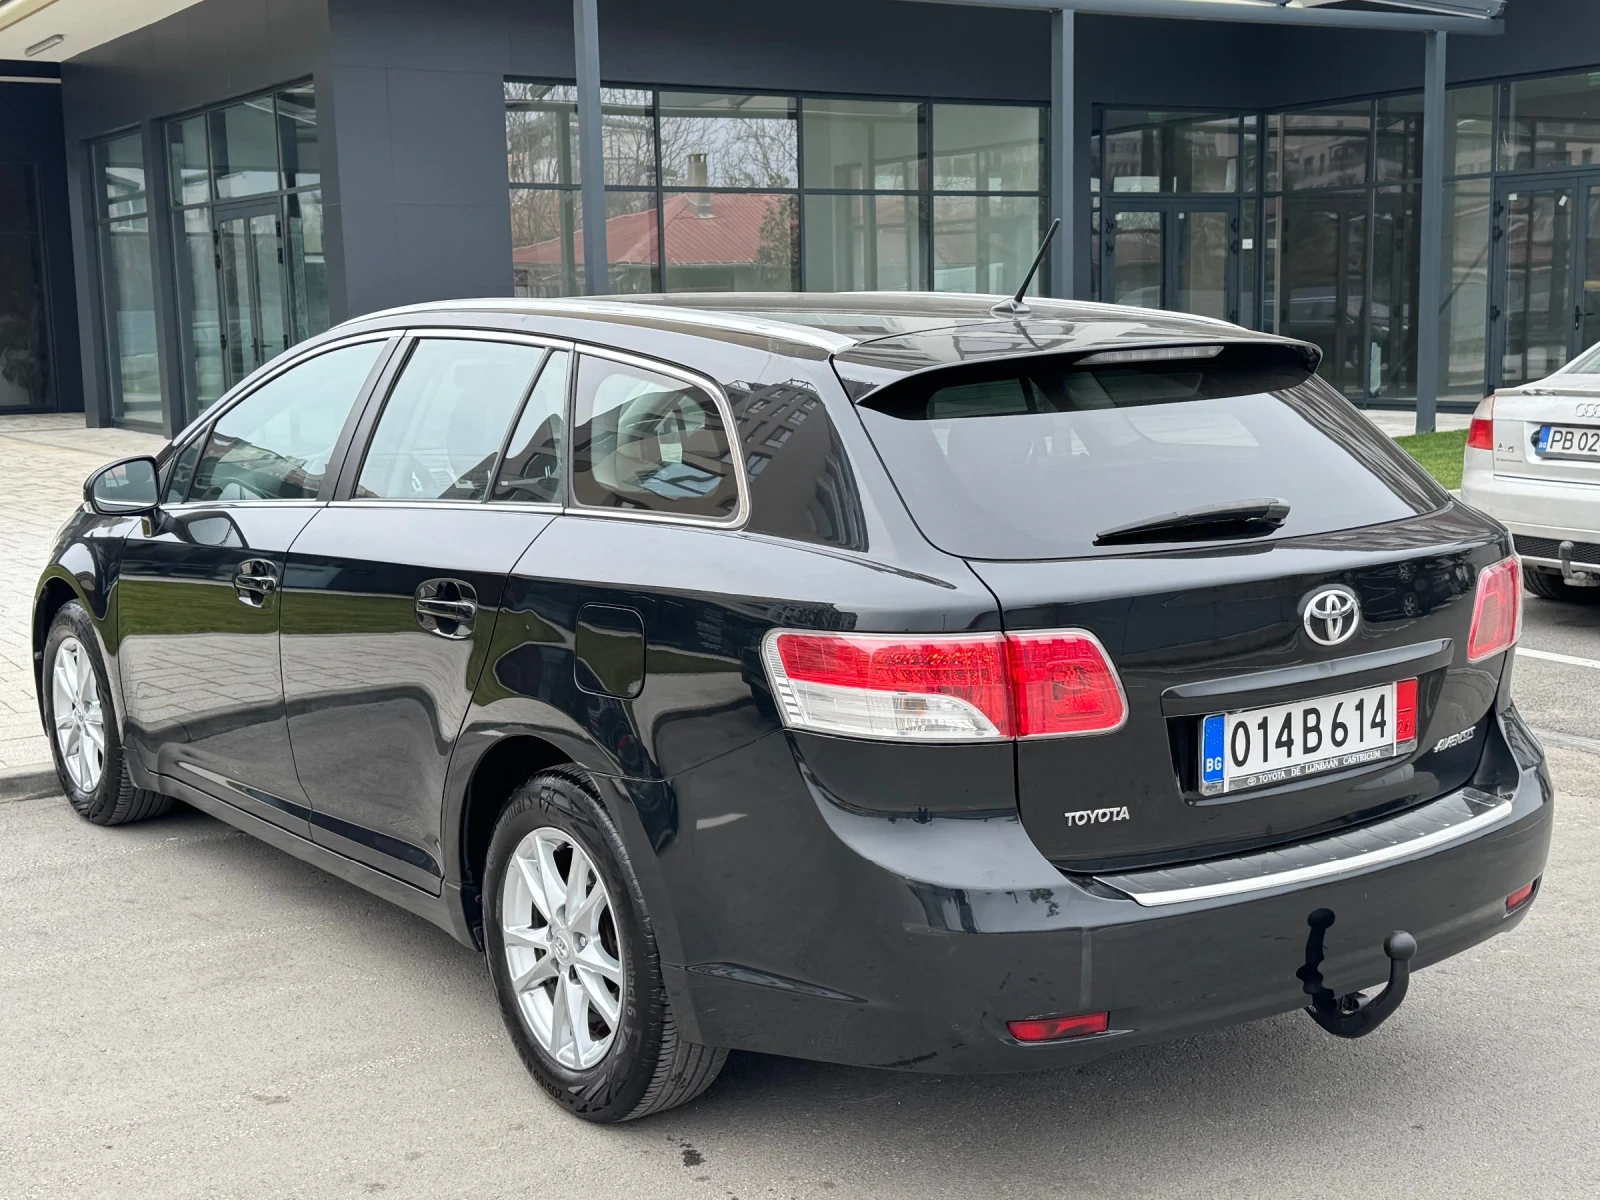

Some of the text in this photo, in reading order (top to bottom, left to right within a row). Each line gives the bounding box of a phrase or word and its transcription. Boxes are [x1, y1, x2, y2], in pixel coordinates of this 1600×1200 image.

[1550, 430, 1600, 452] PB 02
[1231, 694, 1387, 767] 014B614
[1206, 756, 1222, 773] BG
[1259, 750, 1381, 783] TOYOTA DE LIJNBAAN CASTRICUM
[1064, 806, 1130, 827] TOYOTA
